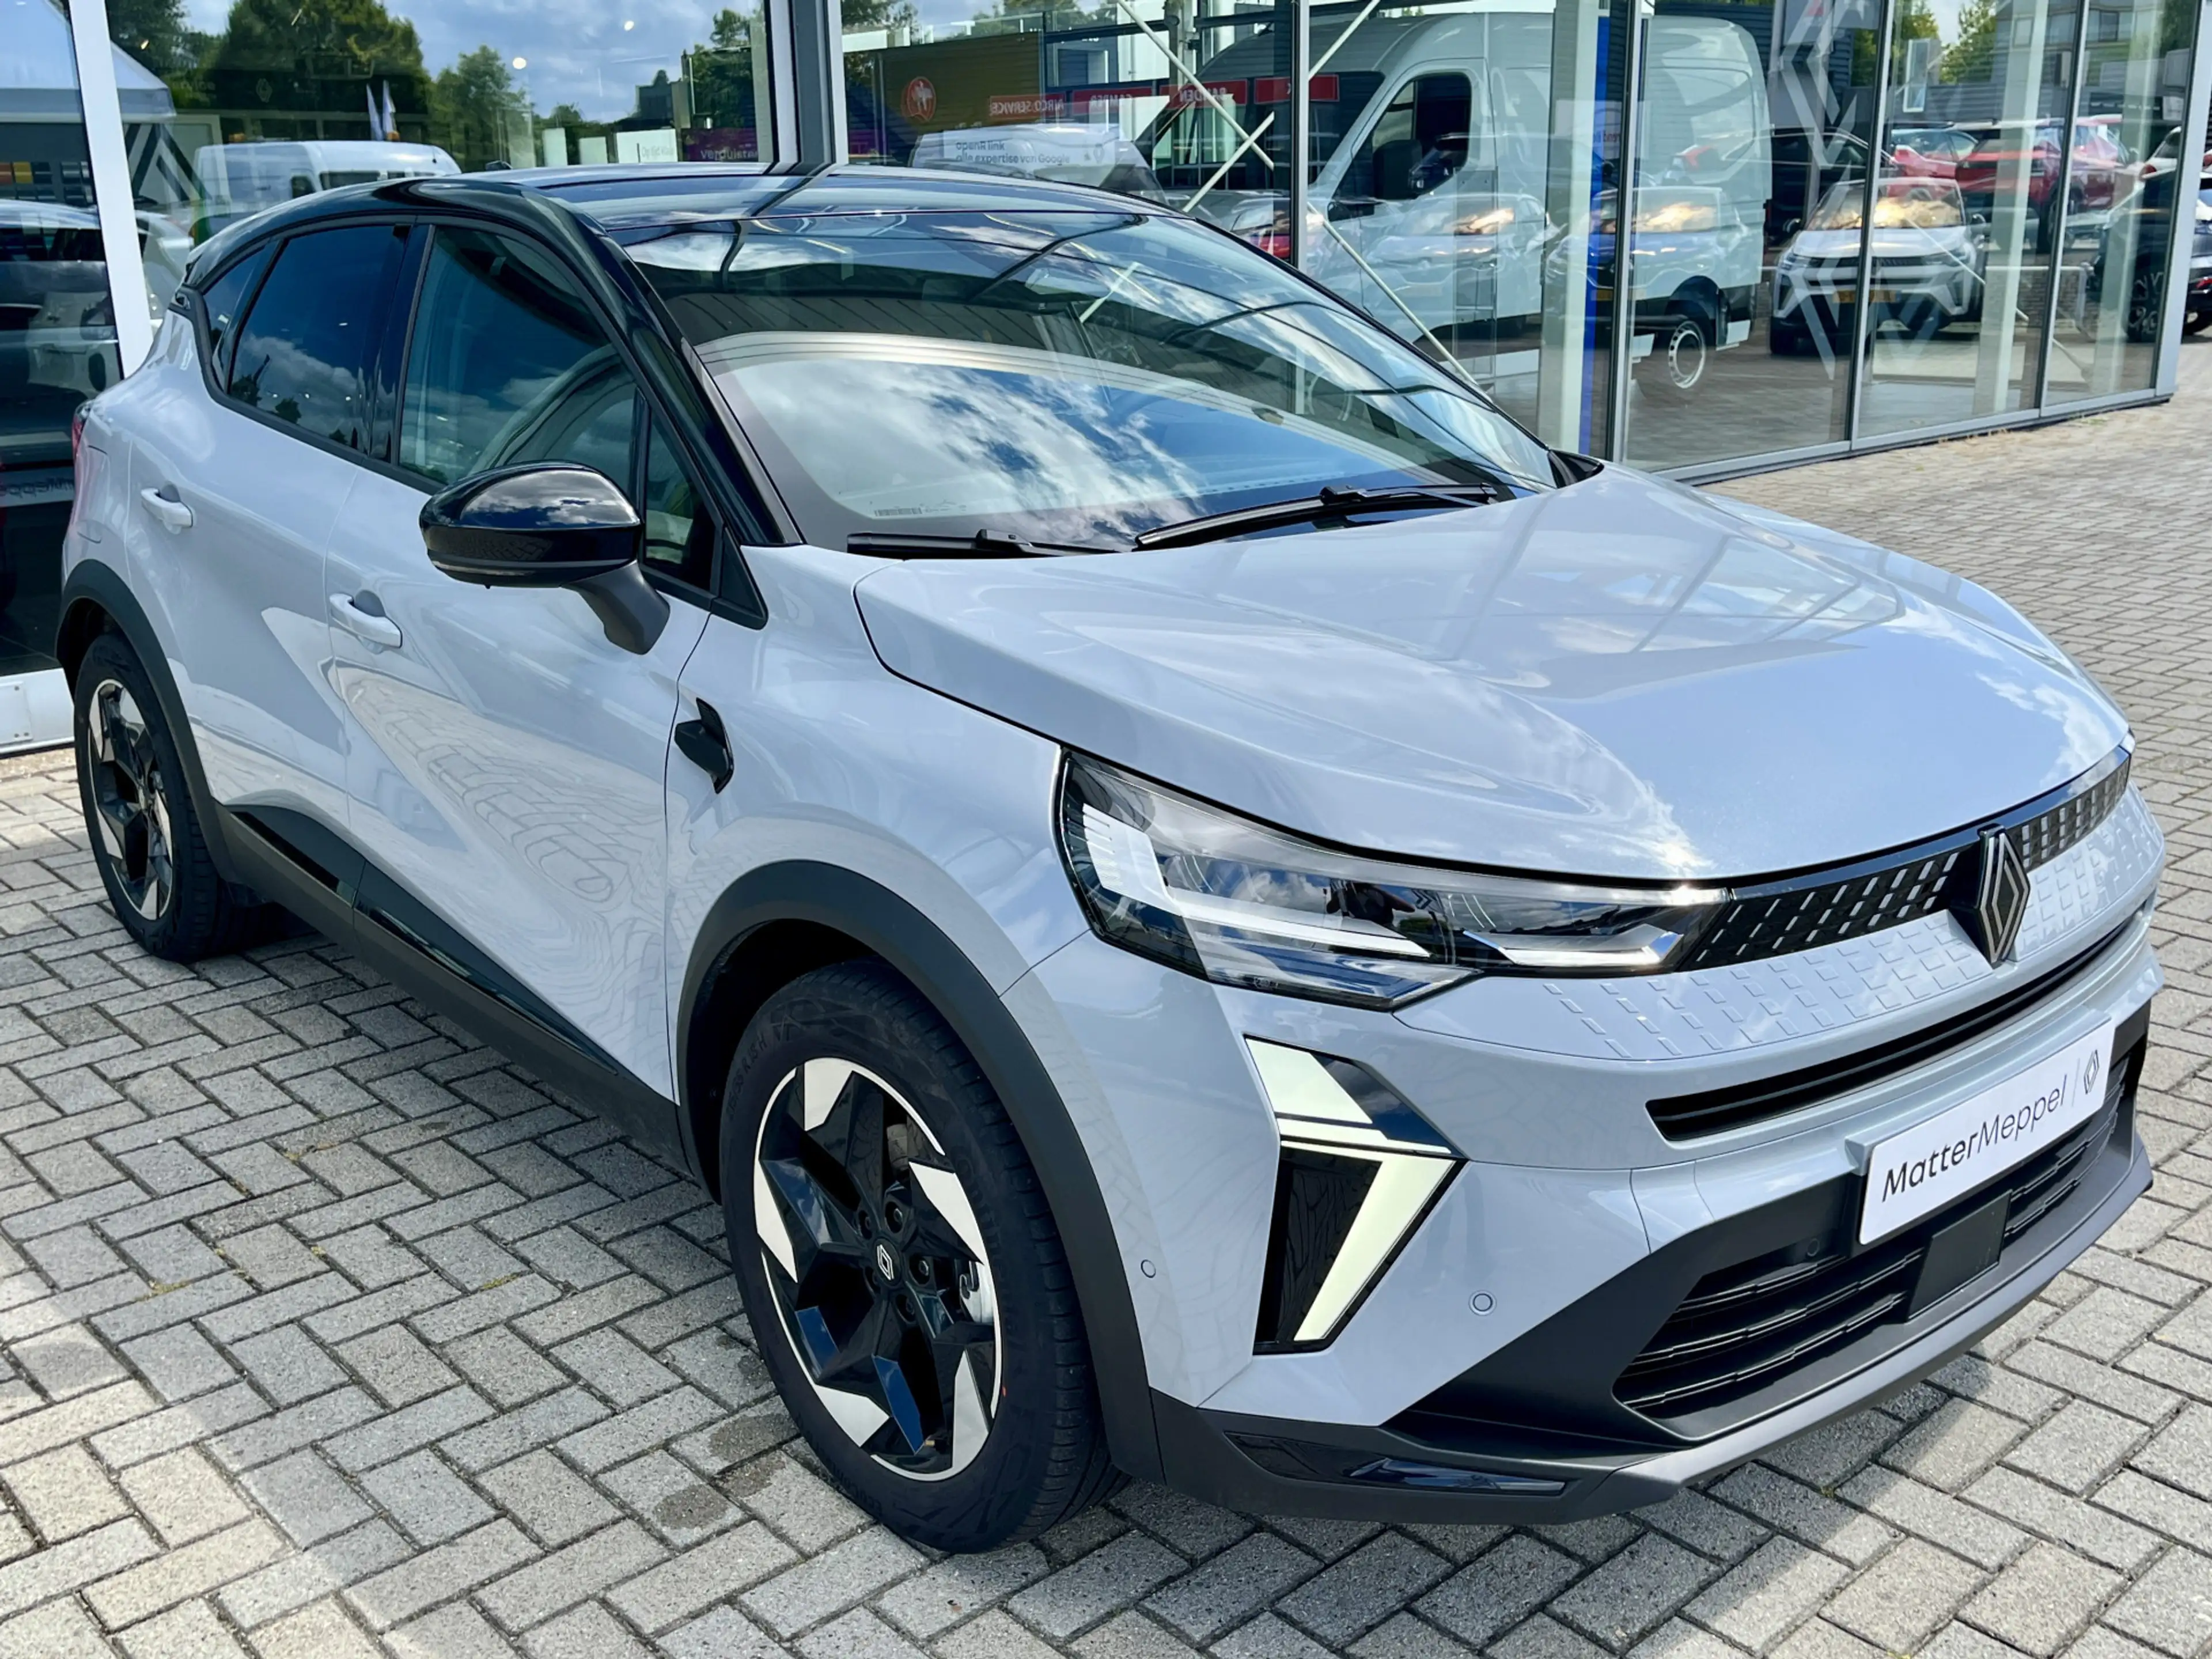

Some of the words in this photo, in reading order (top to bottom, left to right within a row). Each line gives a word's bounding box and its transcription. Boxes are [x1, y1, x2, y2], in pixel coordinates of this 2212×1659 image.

[987, 141, 1005, 150] link
[975, 153, 1018, 164] expertise
[1038, 154, 1070, 165] Google
[1882, 1073, 2067, 1201] MatterMeppel
